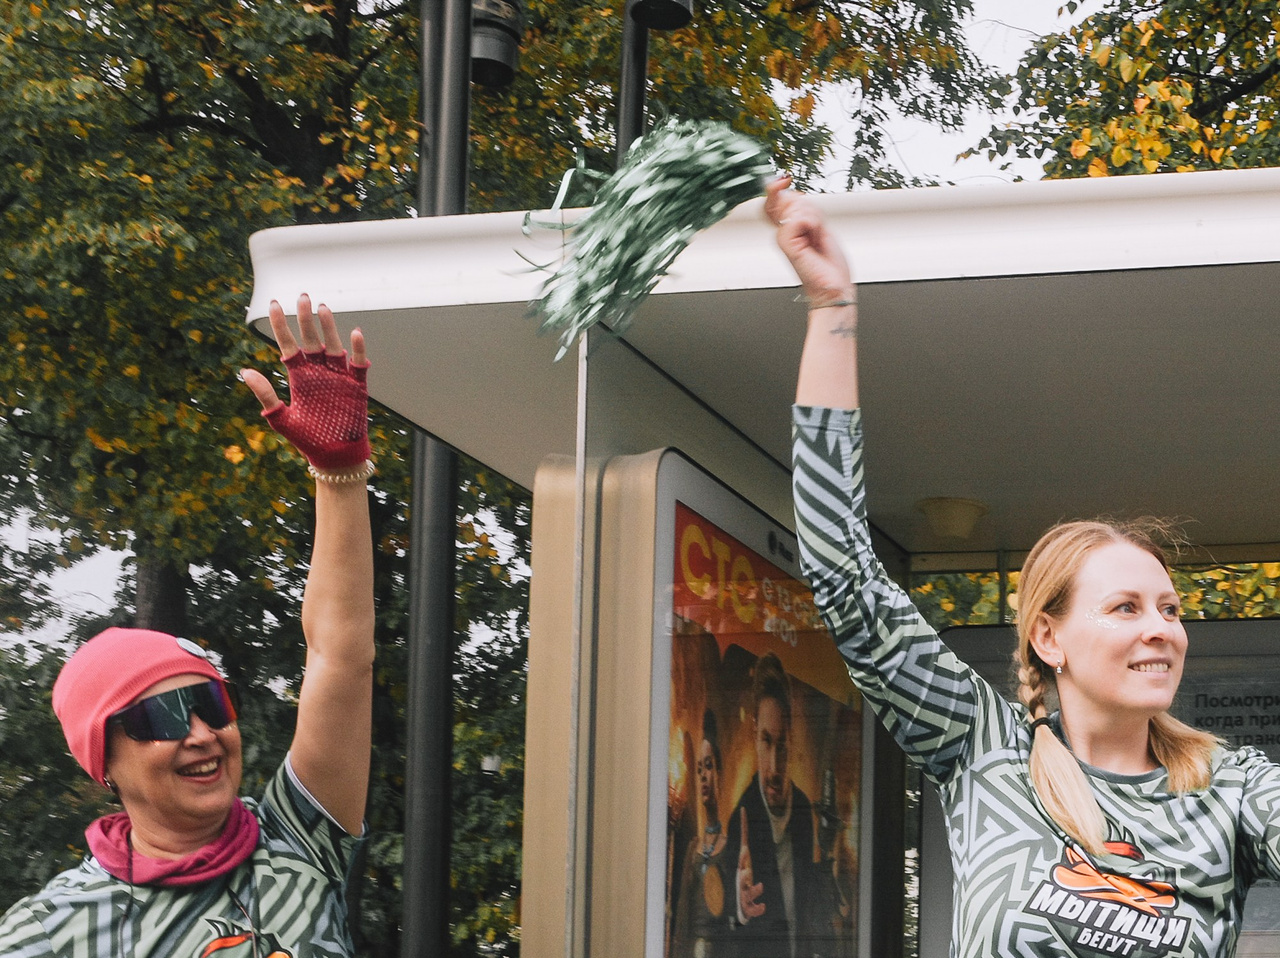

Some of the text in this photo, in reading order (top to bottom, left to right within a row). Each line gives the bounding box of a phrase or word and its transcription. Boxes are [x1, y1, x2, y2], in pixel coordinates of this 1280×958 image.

[681, 524, 758, 624] СТС
[1194, 715, 1244, 730] когда
[1030, 883, 1188, 949] МЫТИЩИ
[1077, 927, 1138, 956] БЕГУТ
